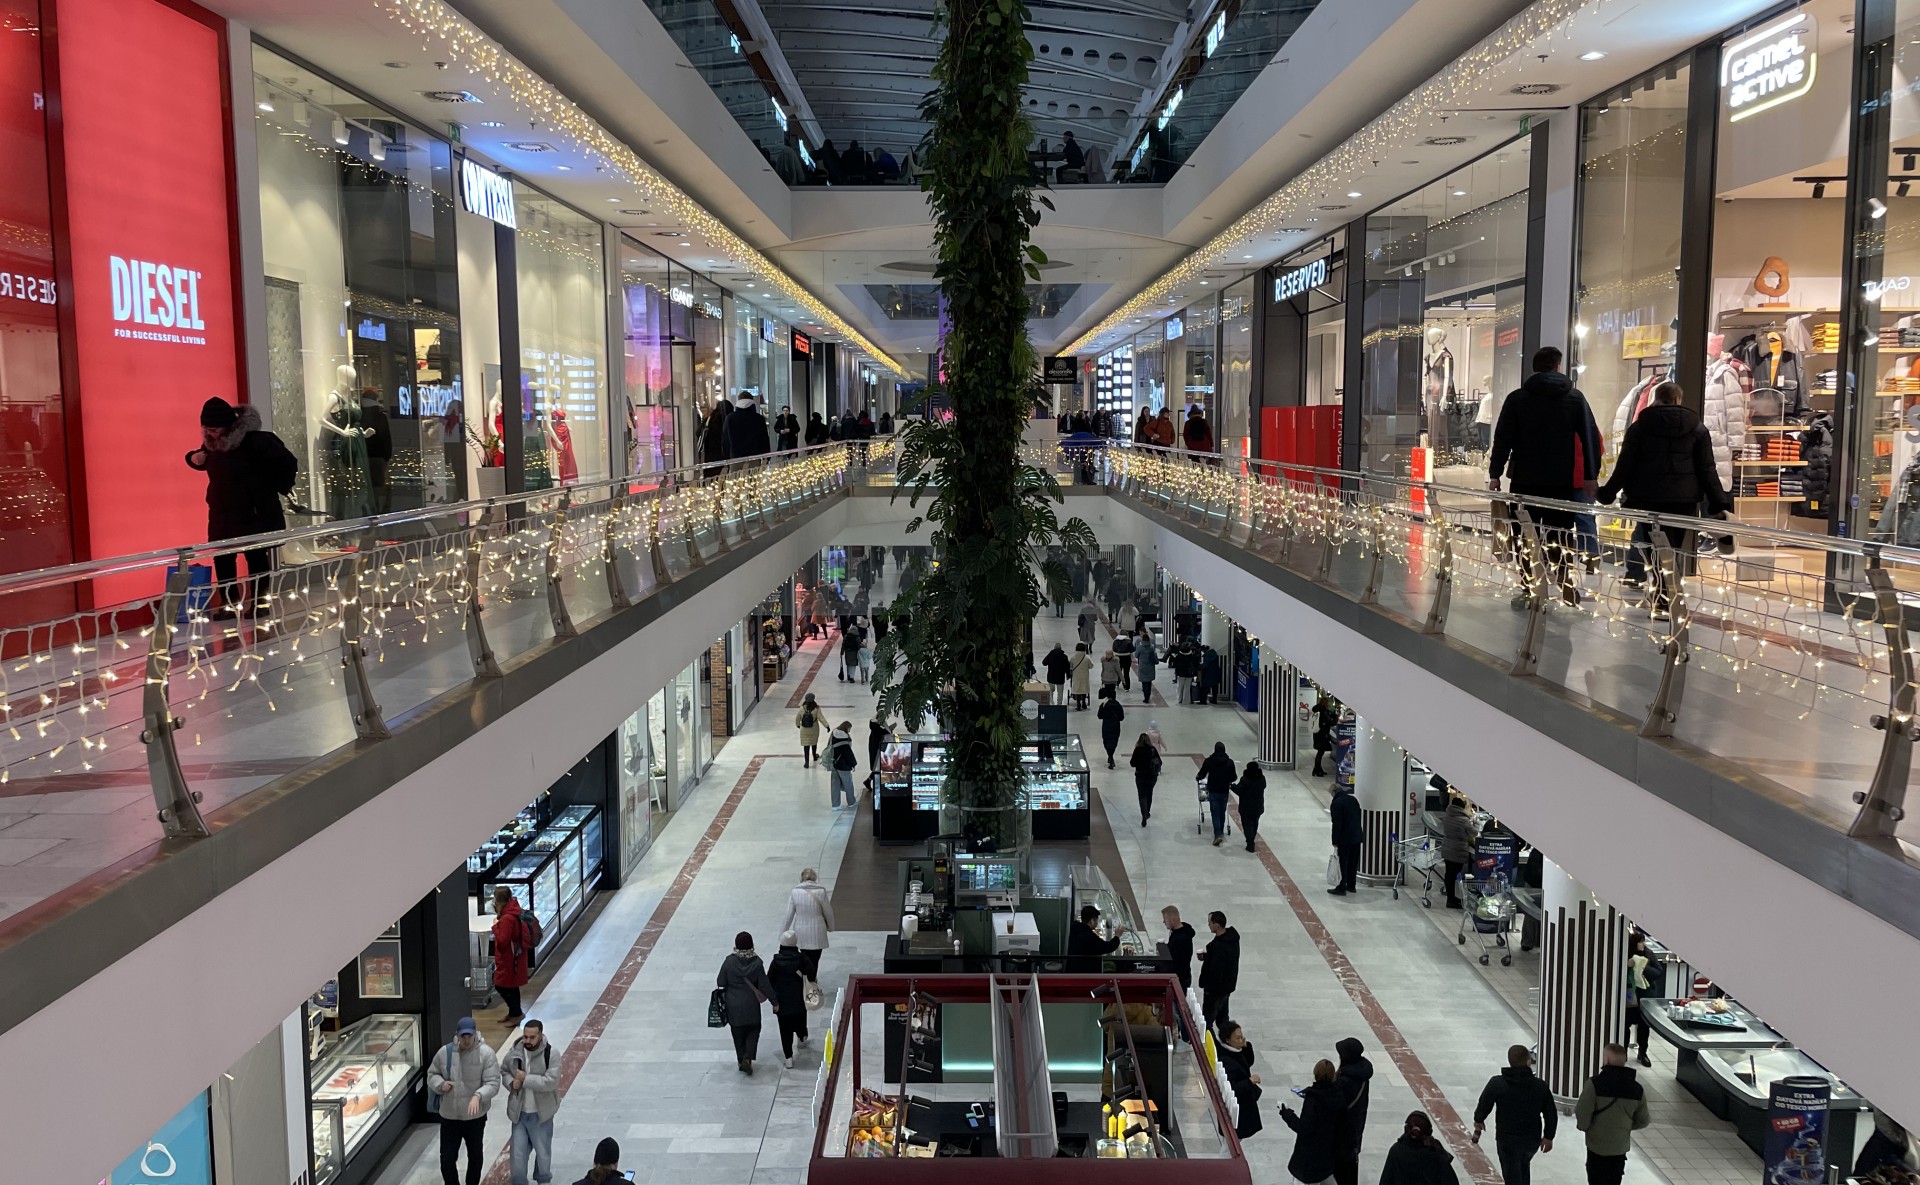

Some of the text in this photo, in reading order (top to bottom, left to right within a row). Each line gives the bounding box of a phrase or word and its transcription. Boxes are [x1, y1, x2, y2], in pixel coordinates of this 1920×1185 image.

[110, 255, 205, 331] DIESEL
[1275, 259, 1326, 302] RESERVED
[114, 328, 206, 345] FOR SUCCESSFUL LIVING
